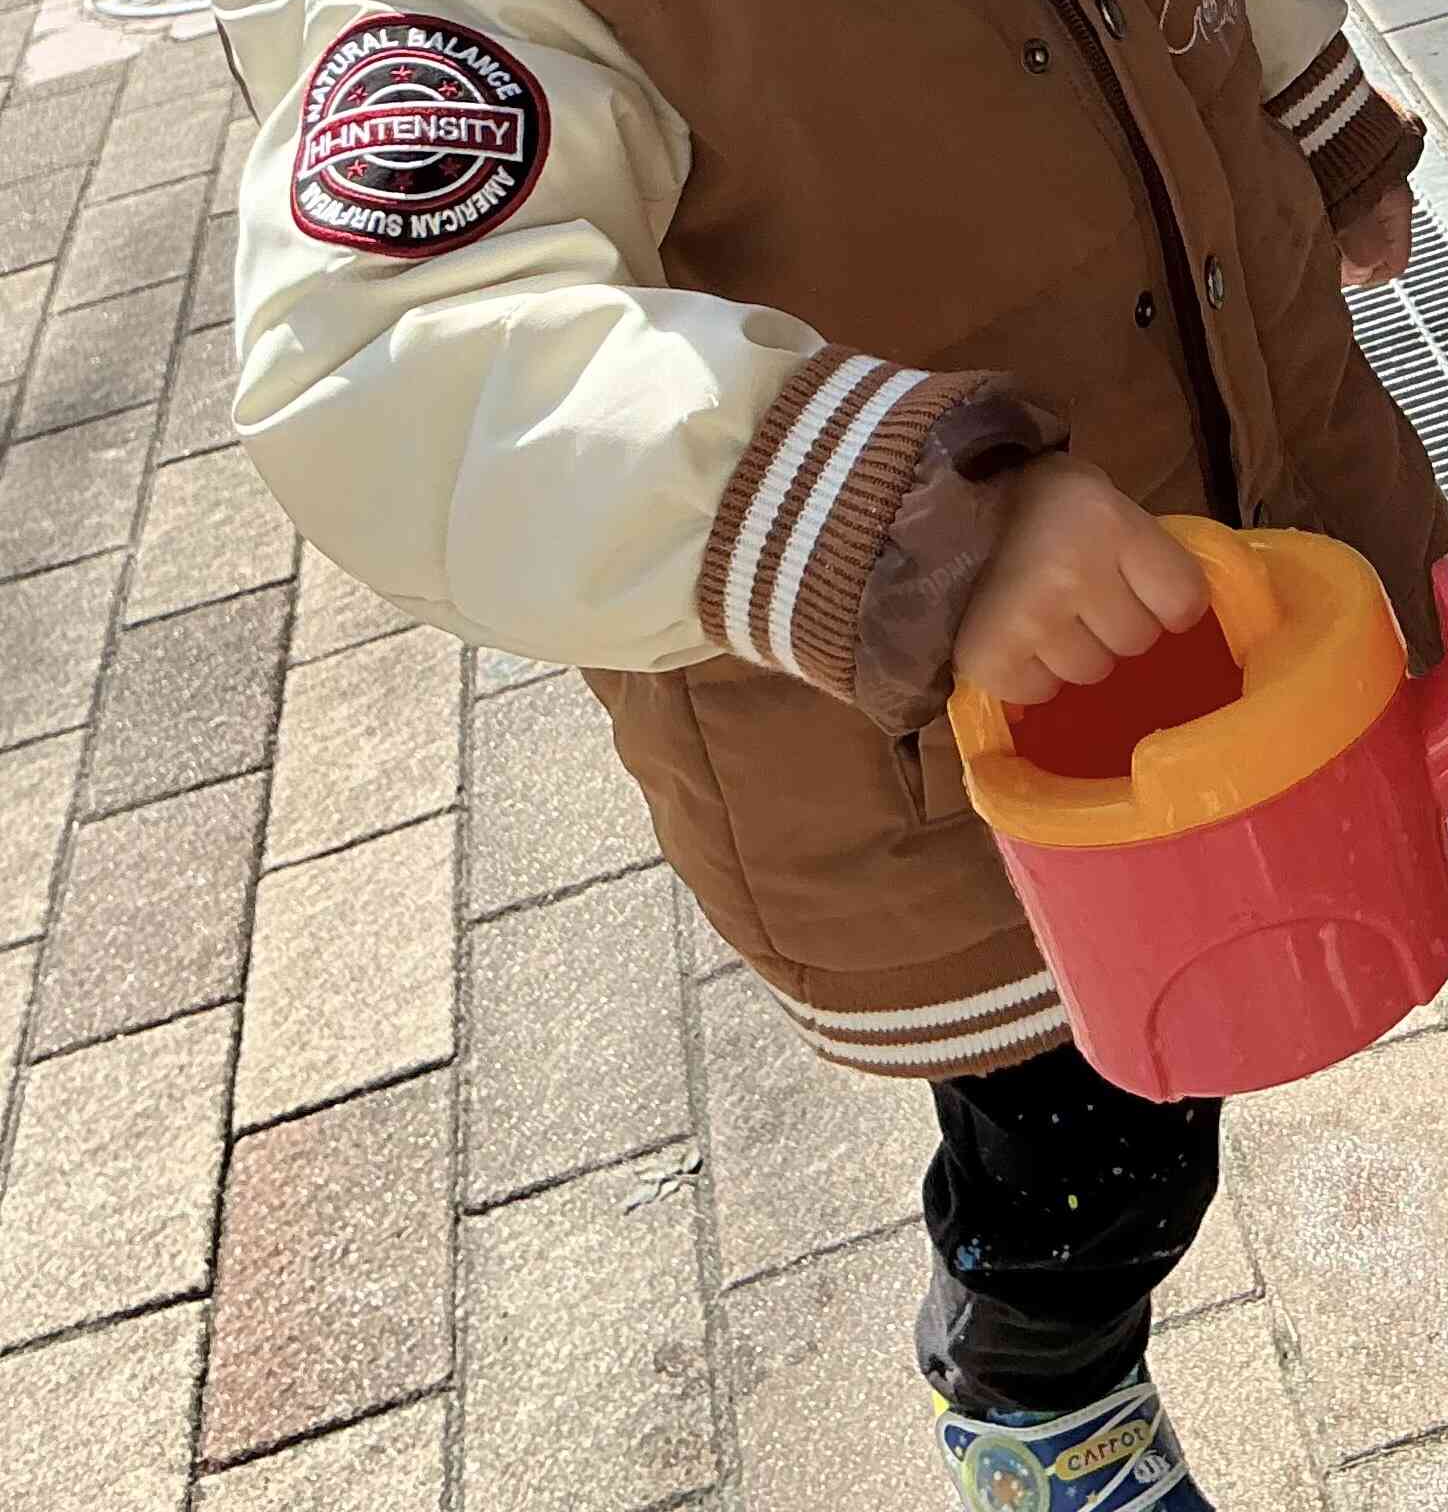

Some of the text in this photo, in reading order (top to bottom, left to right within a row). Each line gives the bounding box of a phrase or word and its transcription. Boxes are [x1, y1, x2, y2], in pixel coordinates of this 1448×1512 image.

[305, 27, 523, 123] NATURAL BALANCE
[411, 164, 516, 239] AMERICAN
